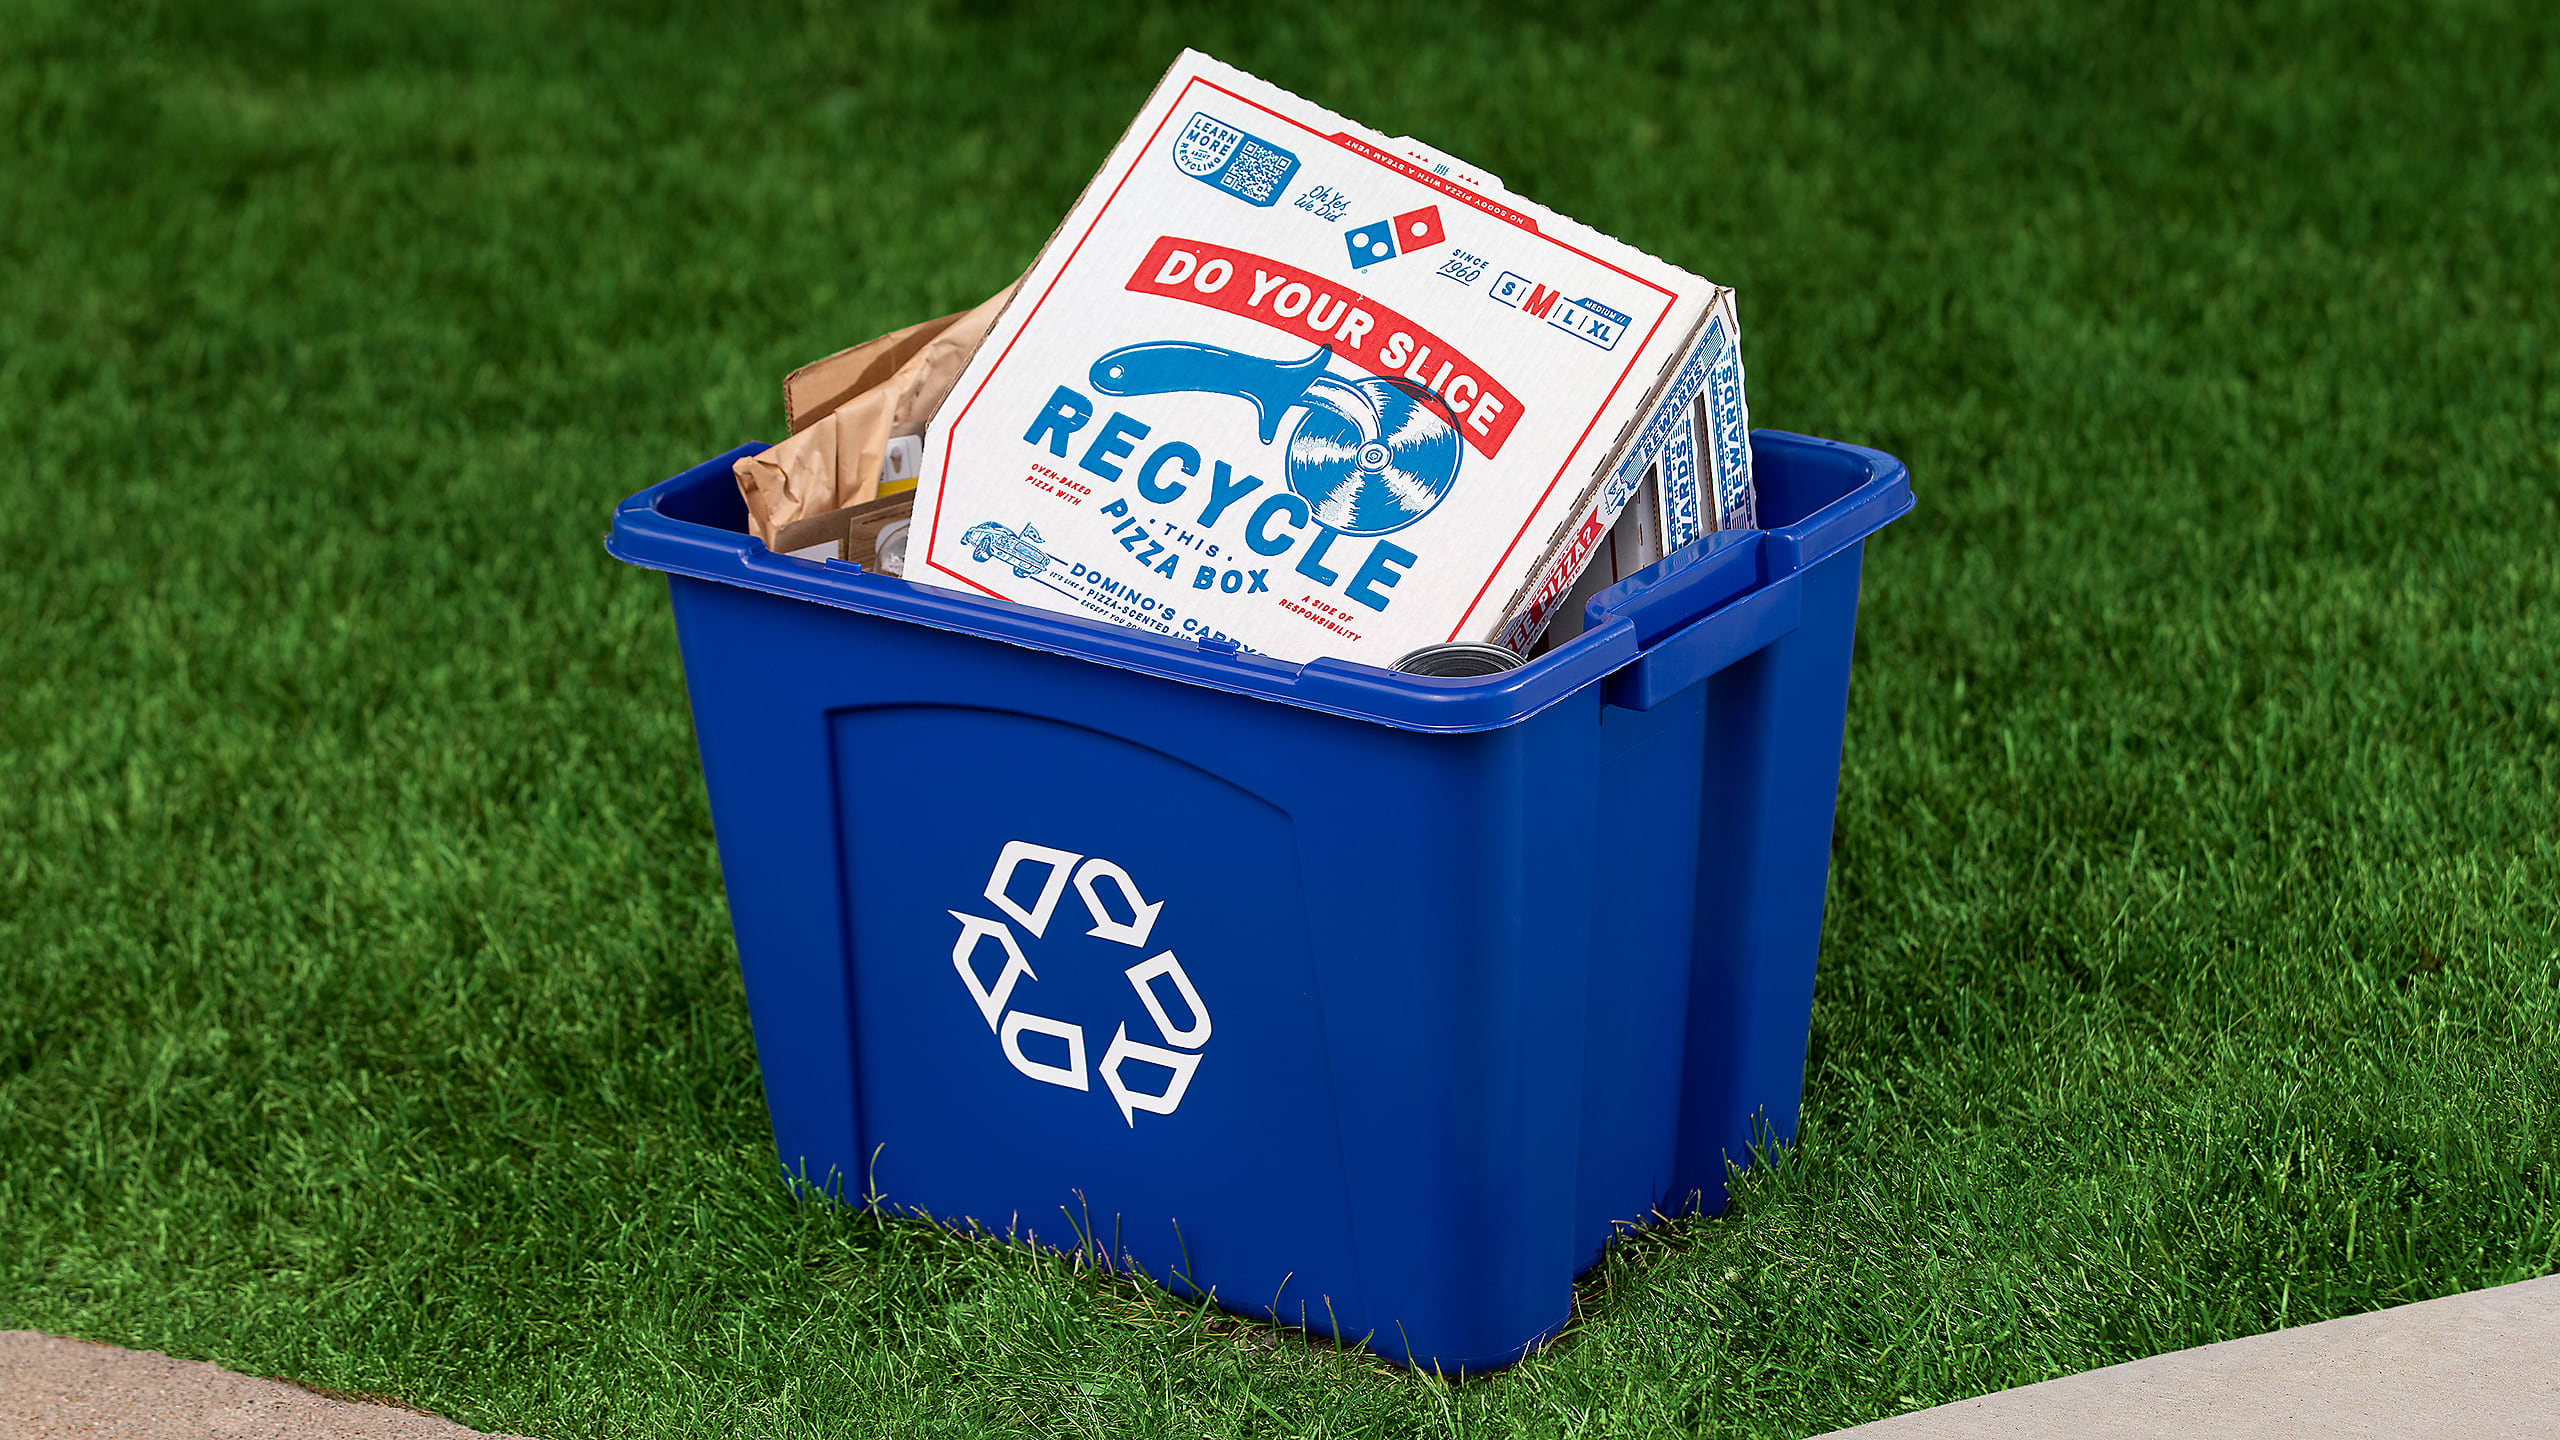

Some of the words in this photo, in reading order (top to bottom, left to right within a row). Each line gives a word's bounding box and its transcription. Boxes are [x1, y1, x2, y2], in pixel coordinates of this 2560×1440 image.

[1186, 129, 1231, 156] MORE
[1194, 118, 1238, 145] LEARN
[1179, 142, 1221, 171] RECYCLING
[1345, 139, 1370, 155] VENT
[1373, 152, 1405, 170] STEAM
[1408, 167, 1415, 175] A
[1417, 172, 1441, 188] WITH
[1294, 193, 1314, 211] We
[1313, 203, 1344, 222] Did
[1309, 185, 1333, 202] Oh
[1327, 191, 1351, 211] Yes
[1445, 184, 1473, 201] PIZZA
[1509, 214, 1524, 225] NO
[1439, 259, 1481, 283] 1960
[1452, 248, 1489, 270] SINCE
[1501, 281, 1516, 296] S
[1521, 283, 1561, 320] M
[1562, 308, 1575, 326] L
[1587, 319, 1611, 342] XL
[1154, 249, 1233, 293] DO
[1248, 269, 1376, 344] YOUR
[1379, 331, 1502, 438] SLICE
[1643, 364, 1703, 459] REWARDS
[1722, 365, 1745, 510] REWARDS
[1025, 475, 1054, 493] PIZZA
[1055, 489, 1082, 506] WITH
[1031, 463, 1091, 495] OVEN-BAKED
[1676, 439, 1693, 546] WARDS
[1023, 385, 1418, 612] RECYCLE
[1100, 498, 1180, 580] PIZZA
[1192, 564, 1270, 594] BOX
[1164, 521, 1220, 558] THIS
[1538, 526, 1592, 612] PIZZA?
[1069, 562, 1176, 621] DOMINO'S
[1086, 588, 1170, 634] PIZZA-SCENTED
[1278, 598, 1362, 642] RESPONSIBILITY
[1301, 595, 1311, 603] A
[1311, 599, 1338, 615] SIDE
[1338, 612, 1354, 622] OF
